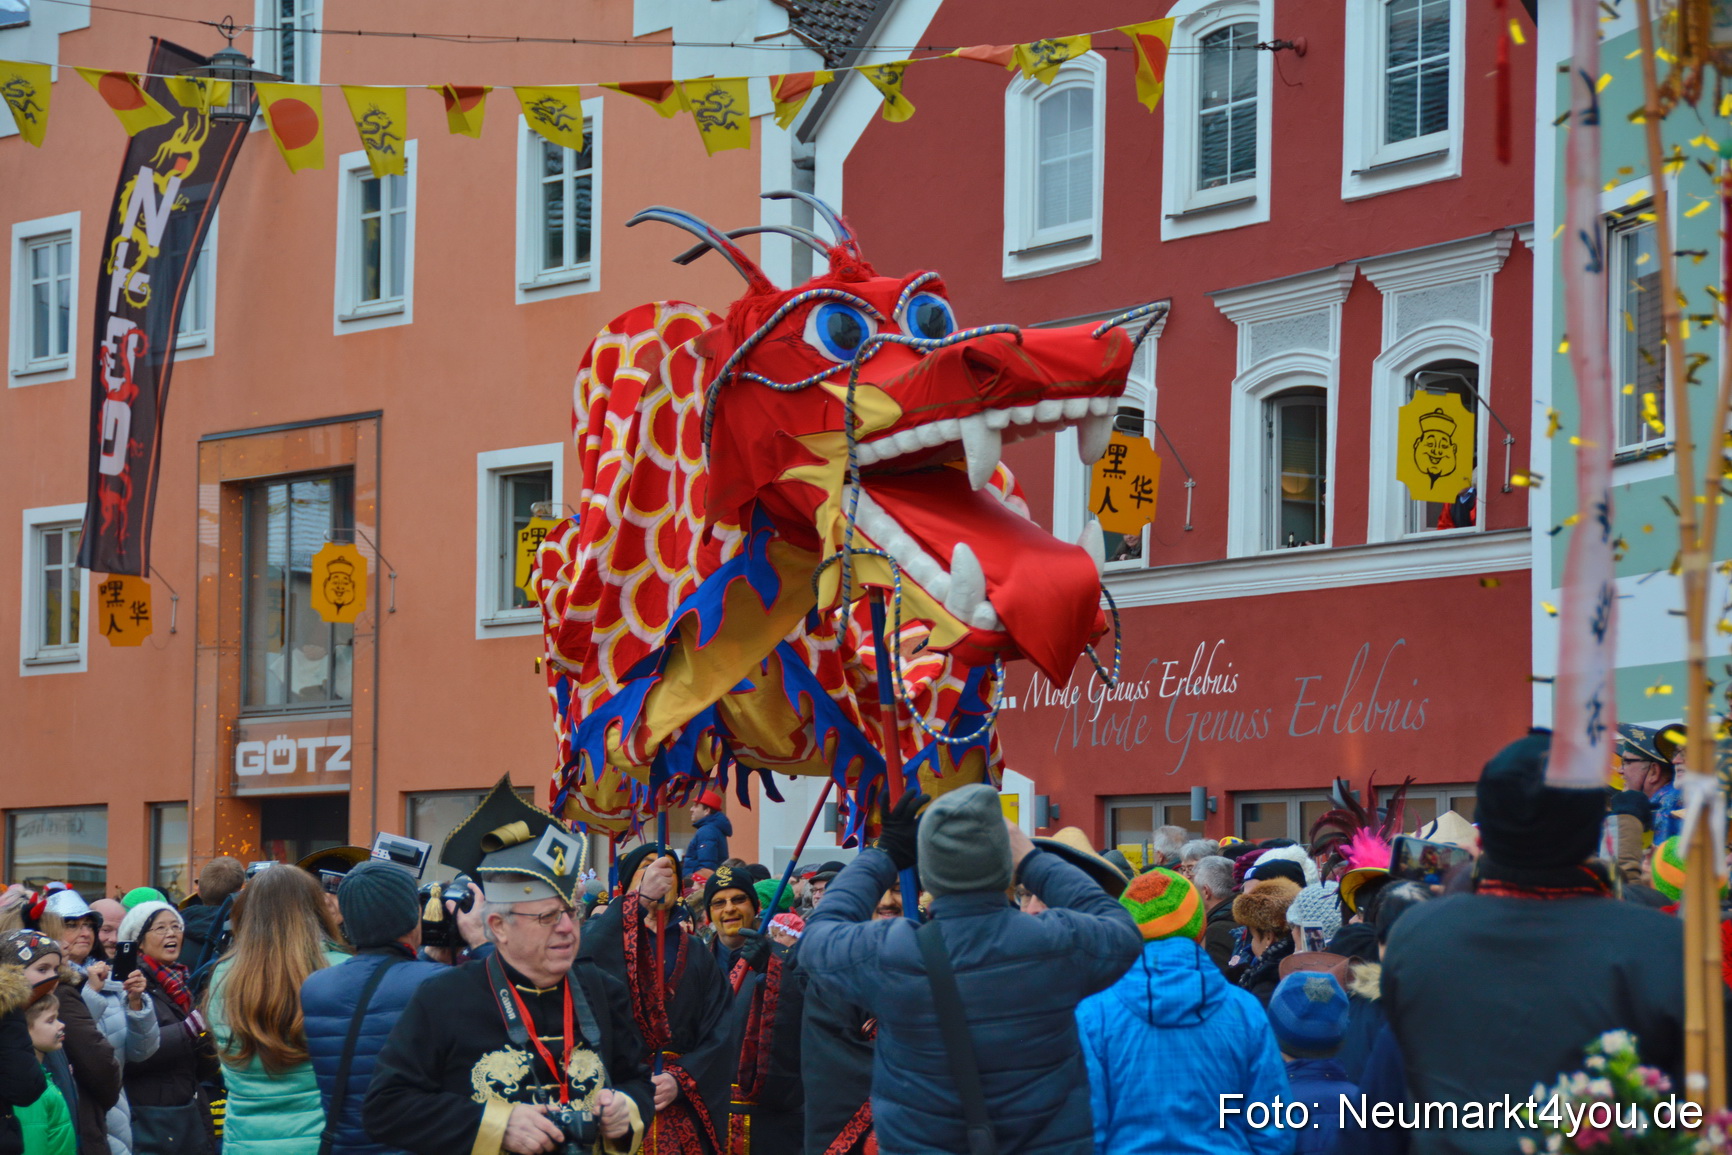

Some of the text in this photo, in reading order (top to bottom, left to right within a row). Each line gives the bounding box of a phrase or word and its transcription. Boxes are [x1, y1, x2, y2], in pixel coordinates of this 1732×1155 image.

[1022, 638, 1239, 723] Mode Genuss Erlebnis
[1053, 637, 1430, 776] Mode Genuss Erlebnis
[235, 734, 351, 777] GÖTZ
[500, 989, 516, 1020] Canon
